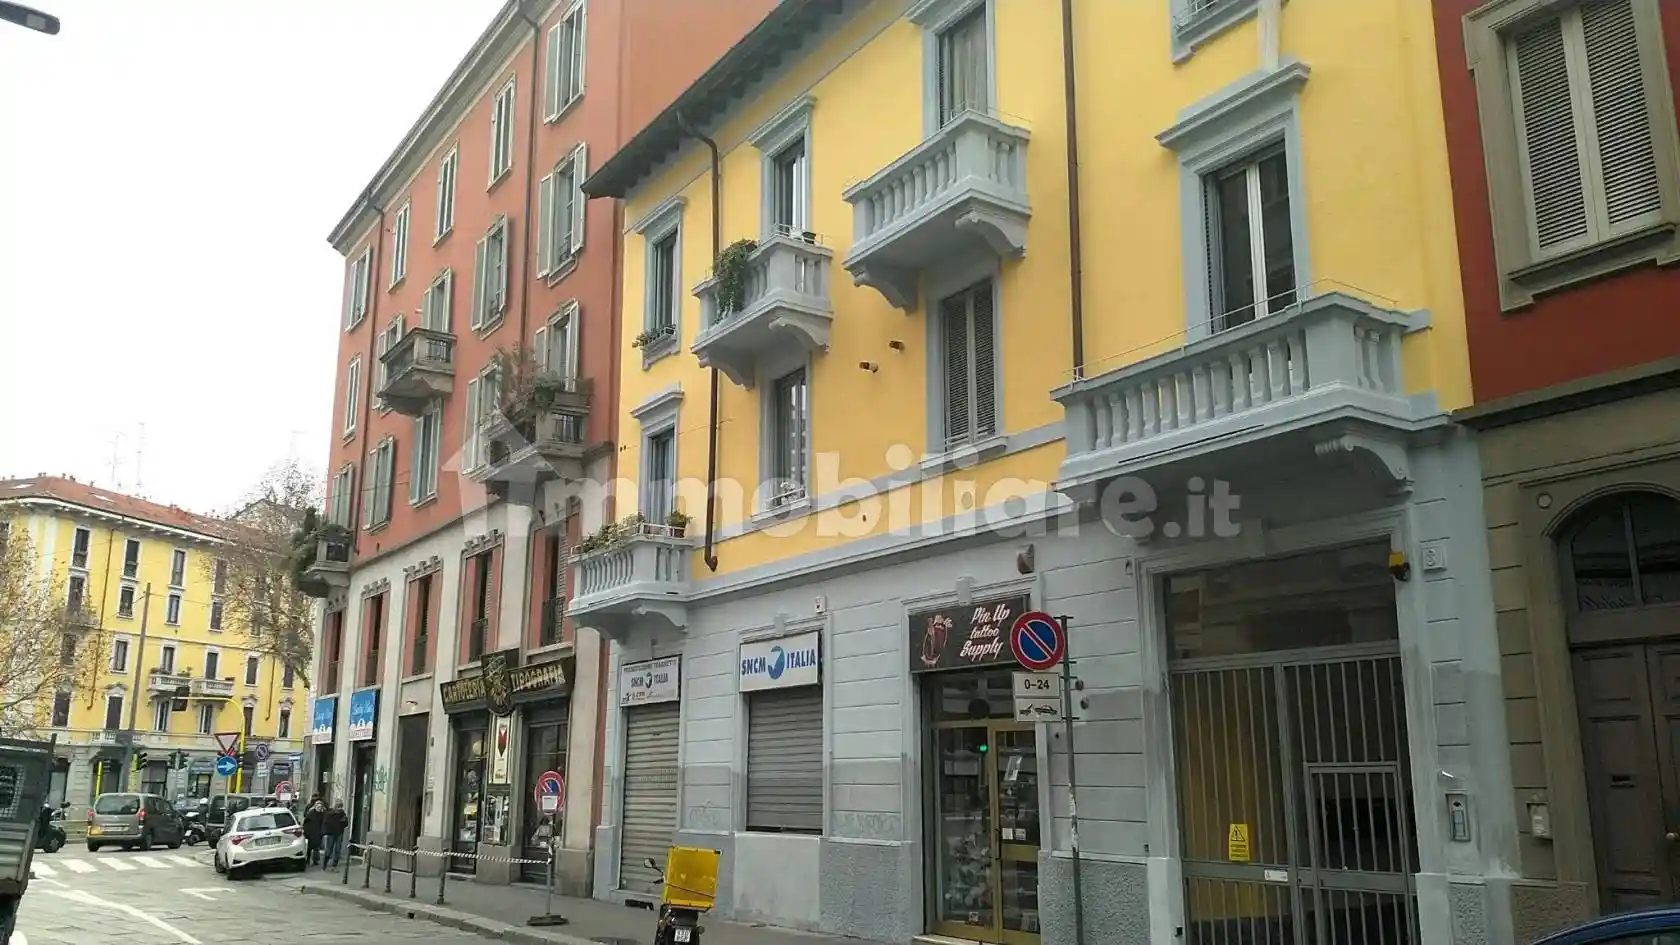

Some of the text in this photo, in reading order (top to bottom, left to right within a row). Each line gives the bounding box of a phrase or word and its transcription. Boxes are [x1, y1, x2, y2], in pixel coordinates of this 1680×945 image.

[970, 603, 1011, 627] Pin Up
[969, 625, 1000, 639] tattoo
[960, 636, 1004, 661] Supply
[741, 649, 816, 675] SNCM ITALIA
[1024, 679, 1050, 690] 0-24
